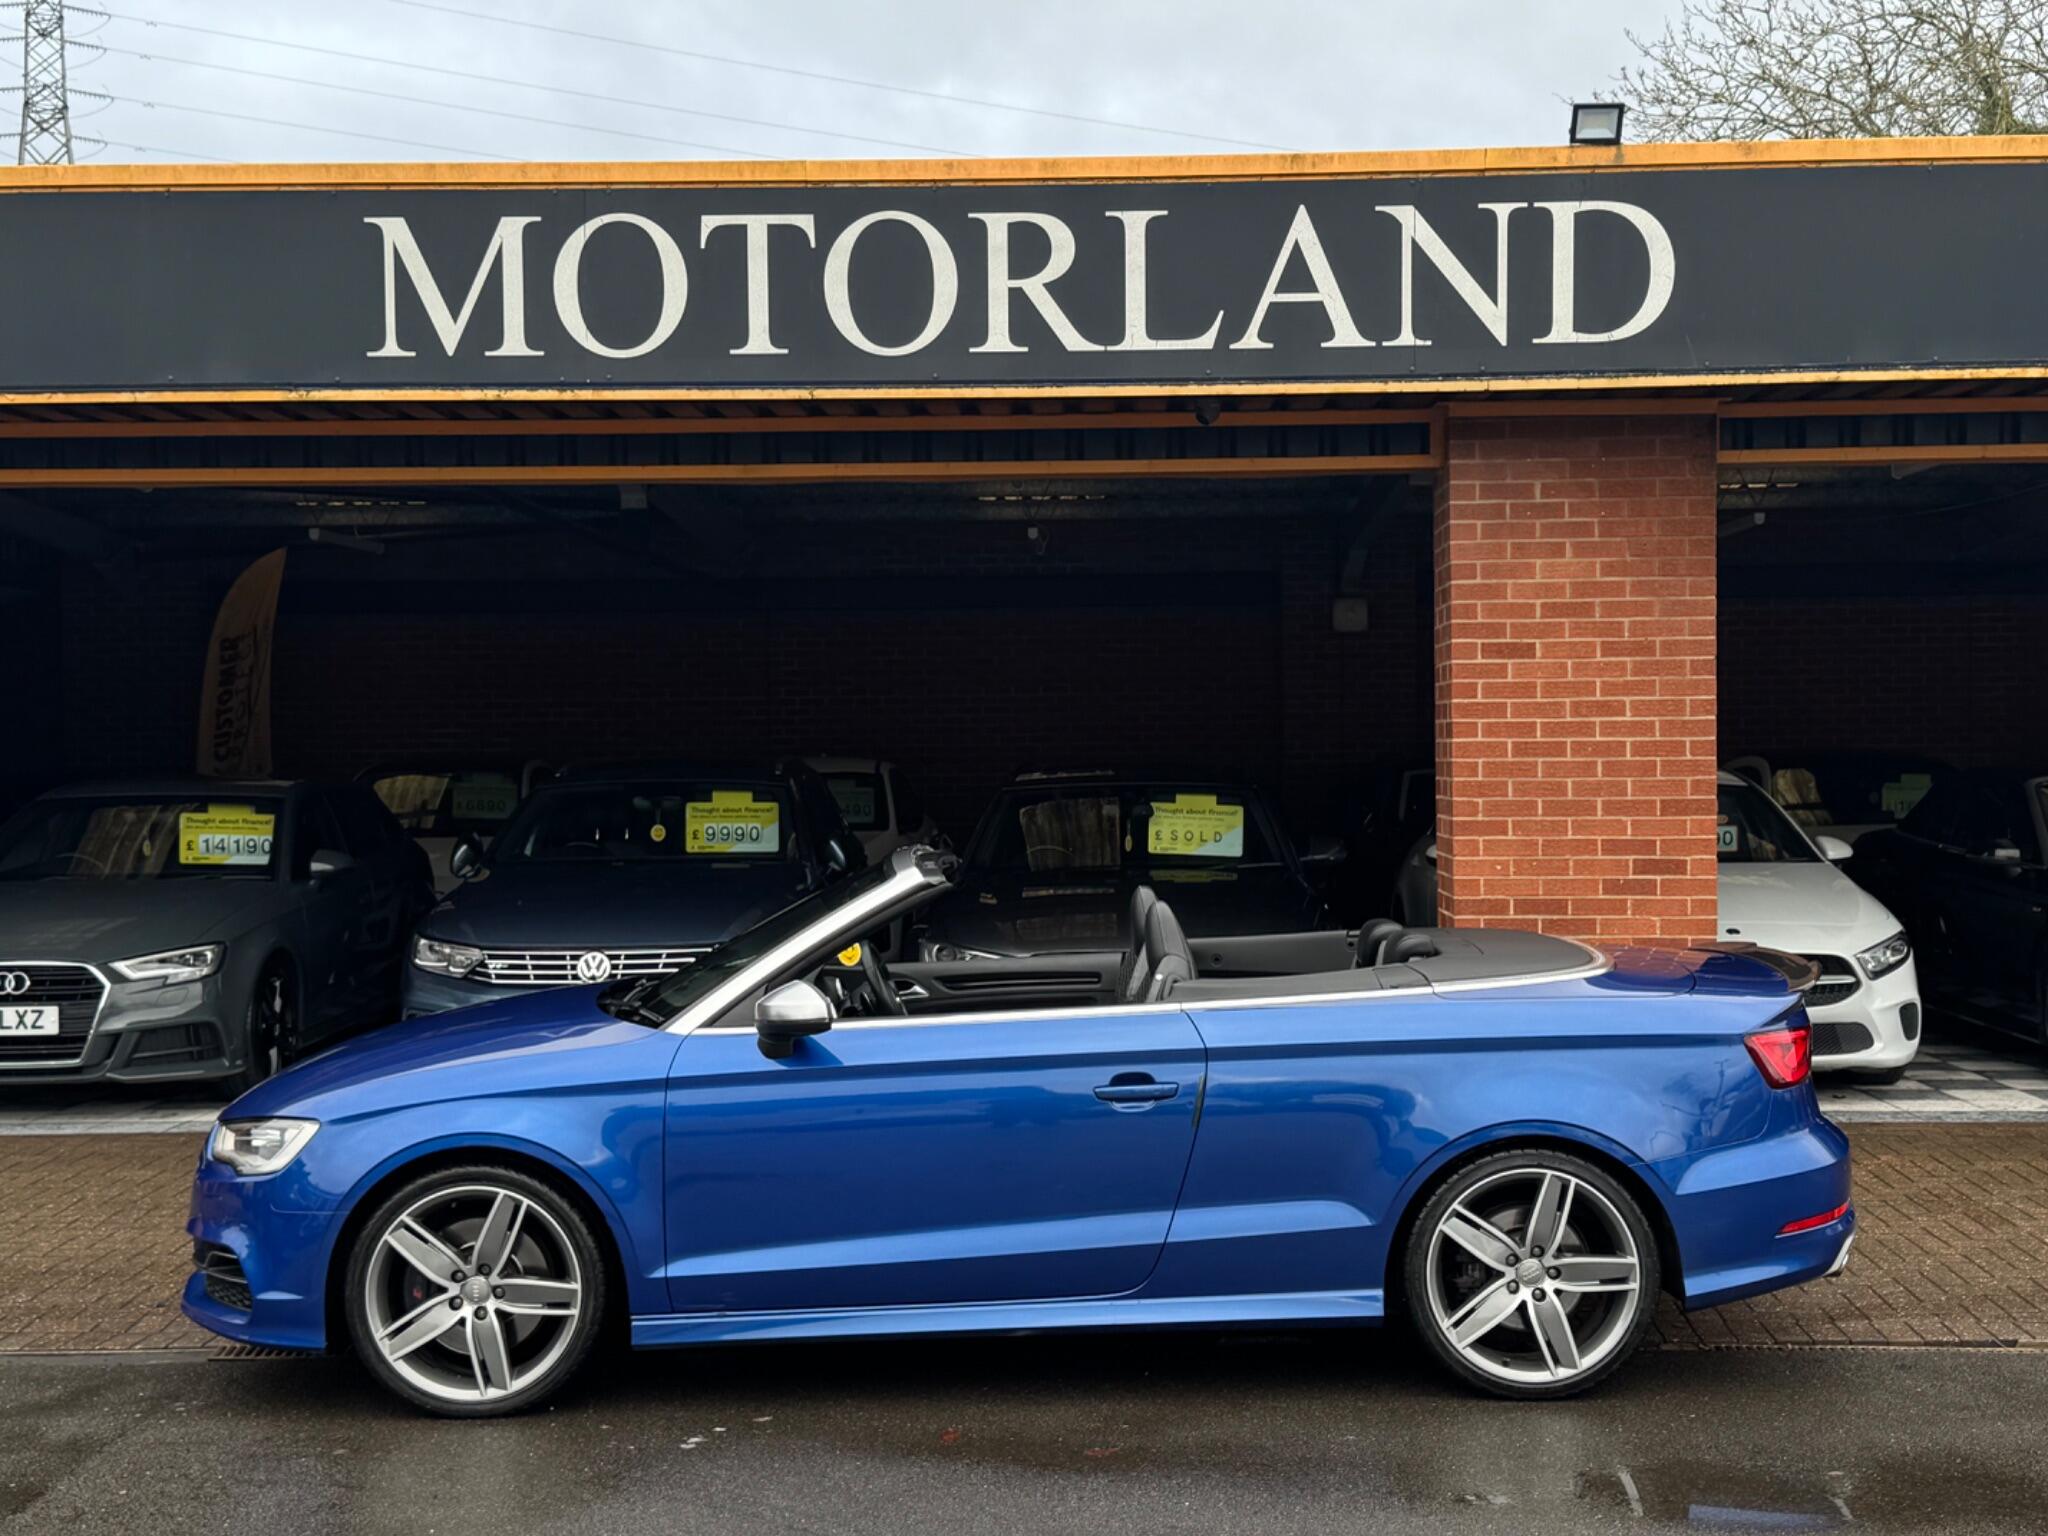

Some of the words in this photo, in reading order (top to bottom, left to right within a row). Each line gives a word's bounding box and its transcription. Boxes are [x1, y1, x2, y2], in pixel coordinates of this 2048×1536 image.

[364, 201, 1676, 358] MOTORLAND
[213, 636, 240, 763] CUSTOMER
[722, 806, 742, 814] about
[218, 817, 239, 825] about
[692, 829, 700, 841] £
[705, 826, 760, 842] 9990
[1155, 830, 1163, 841] £
[1170, 829, 1223, 843] SOLD
[186, 840, 195, 851] £
[202, 838, 272, 854] 14190
[0, 1009, 45, 1030] LXZ
